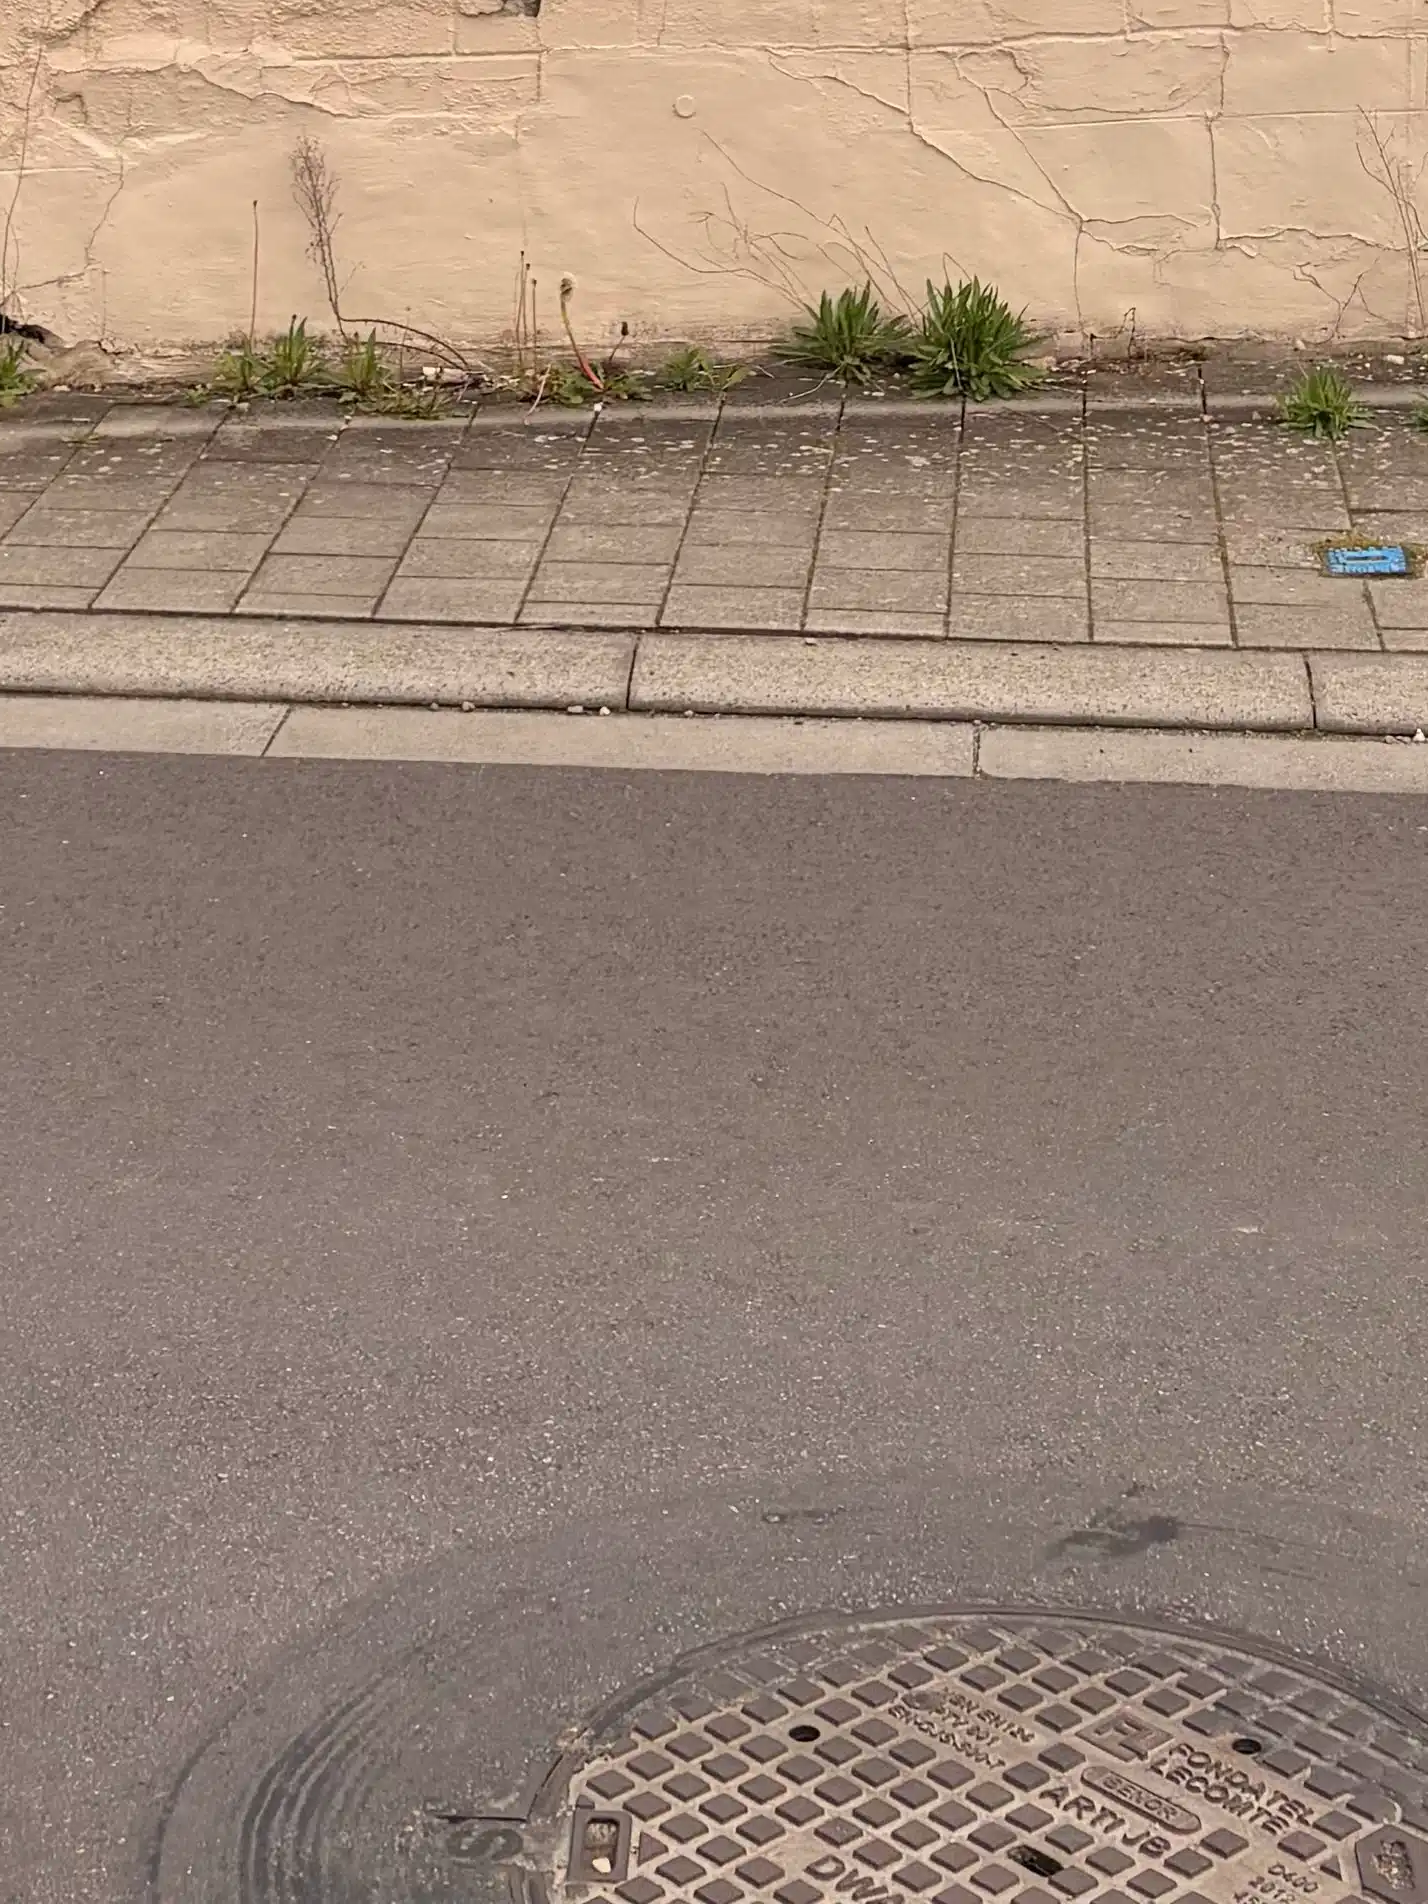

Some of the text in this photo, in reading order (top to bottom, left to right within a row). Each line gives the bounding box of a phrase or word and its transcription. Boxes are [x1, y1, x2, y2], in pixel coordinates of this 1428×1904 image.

[1102, 1775, 1178, 1821] BENOR
[1149, 1758, 1290, 1835] LECOMTE
[1168, 1742, 1314, 1826] FONDATEL
